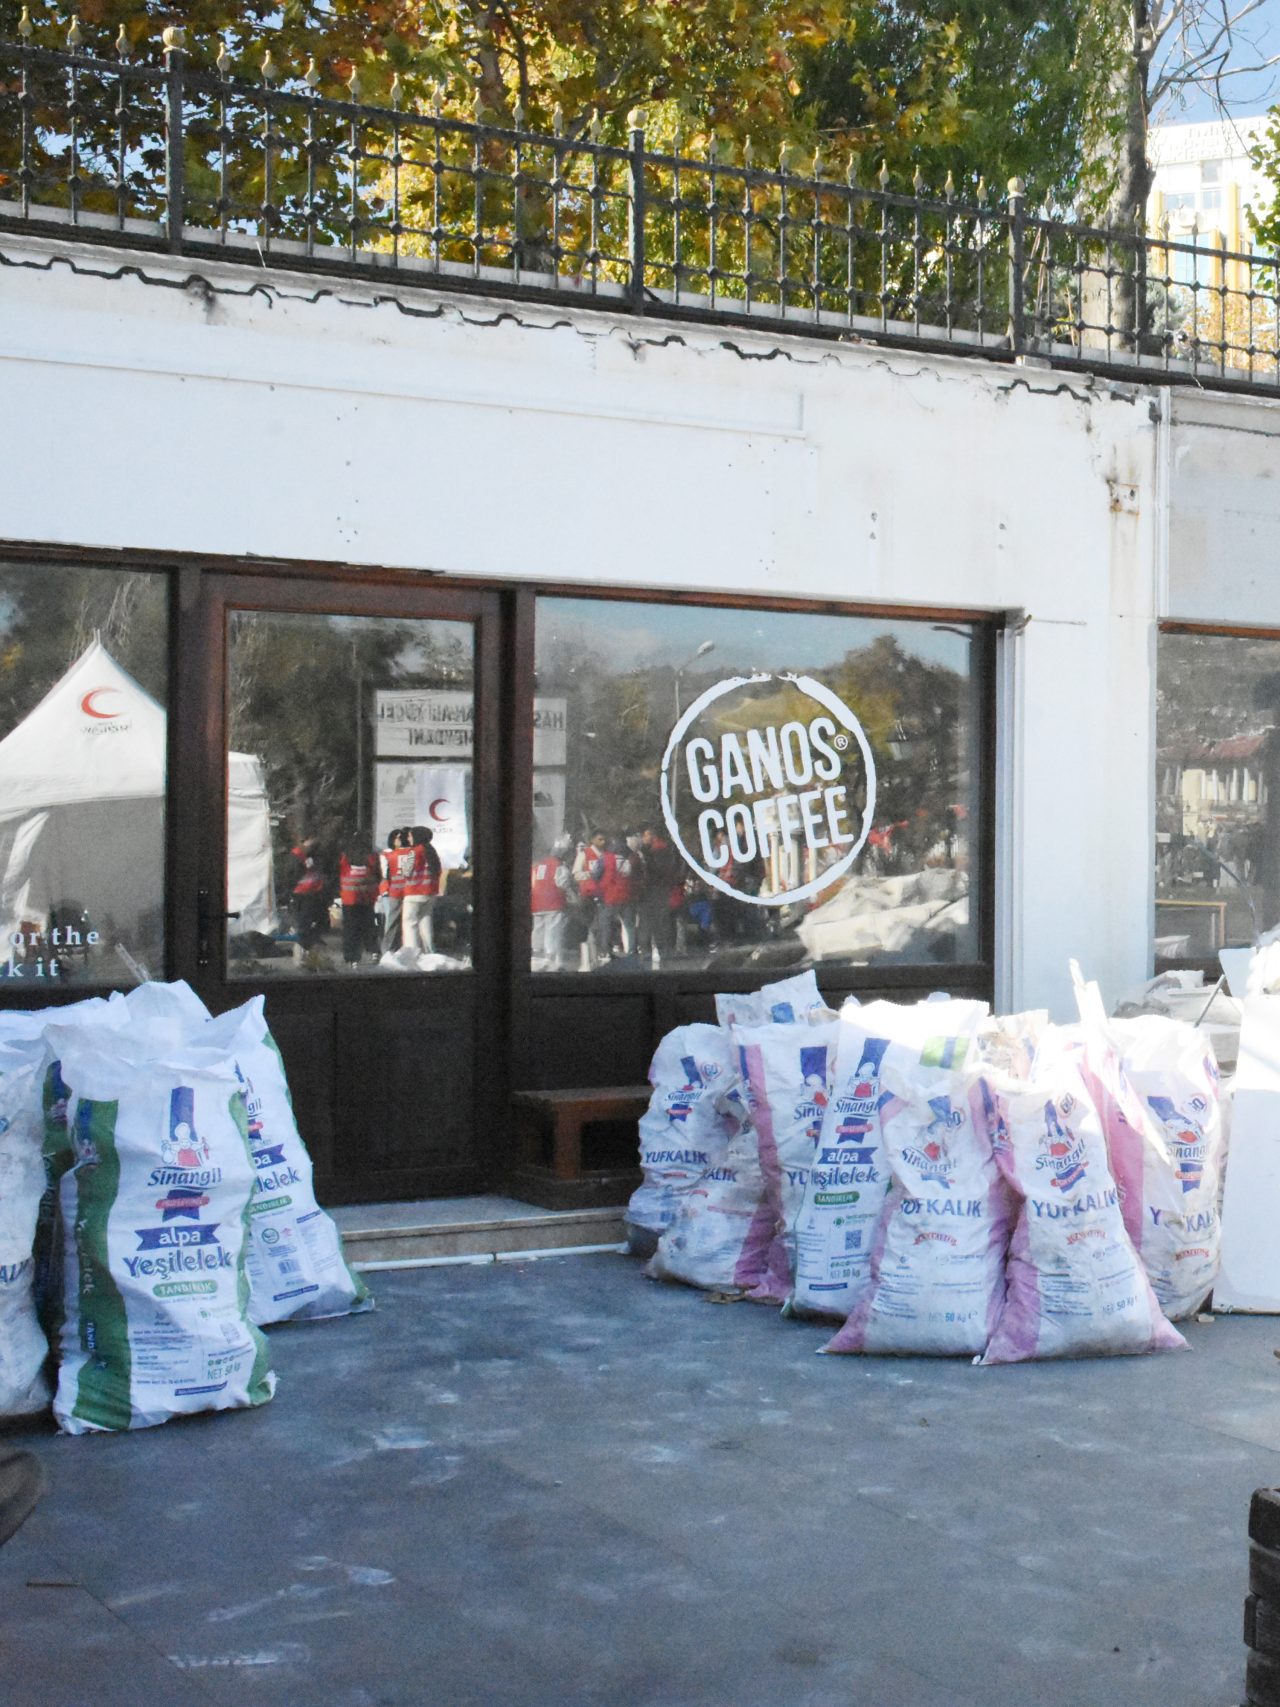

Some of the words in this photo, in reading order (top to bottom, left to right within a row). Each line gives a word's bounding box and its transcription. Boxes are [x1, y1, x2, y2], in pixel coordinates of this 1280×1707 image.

[698, 785, 855, 869] COFFEE
[52, 925, 100, 946] the
[35, 957, 59, 977] it
[646, 1149, 708, 1164] YUFKALIK
[827, 1148, 859, 1163] alpa
[1035, 1138, 1087, 1171] Sinangil
[147, 1167, 222, 1187] Sinangil
[1032, 1187, 1118, 1219] YUFKALIK
[159, 1227, 201, 1248] alpa
[123, 1246, 232, 1281] Yeşilelek
